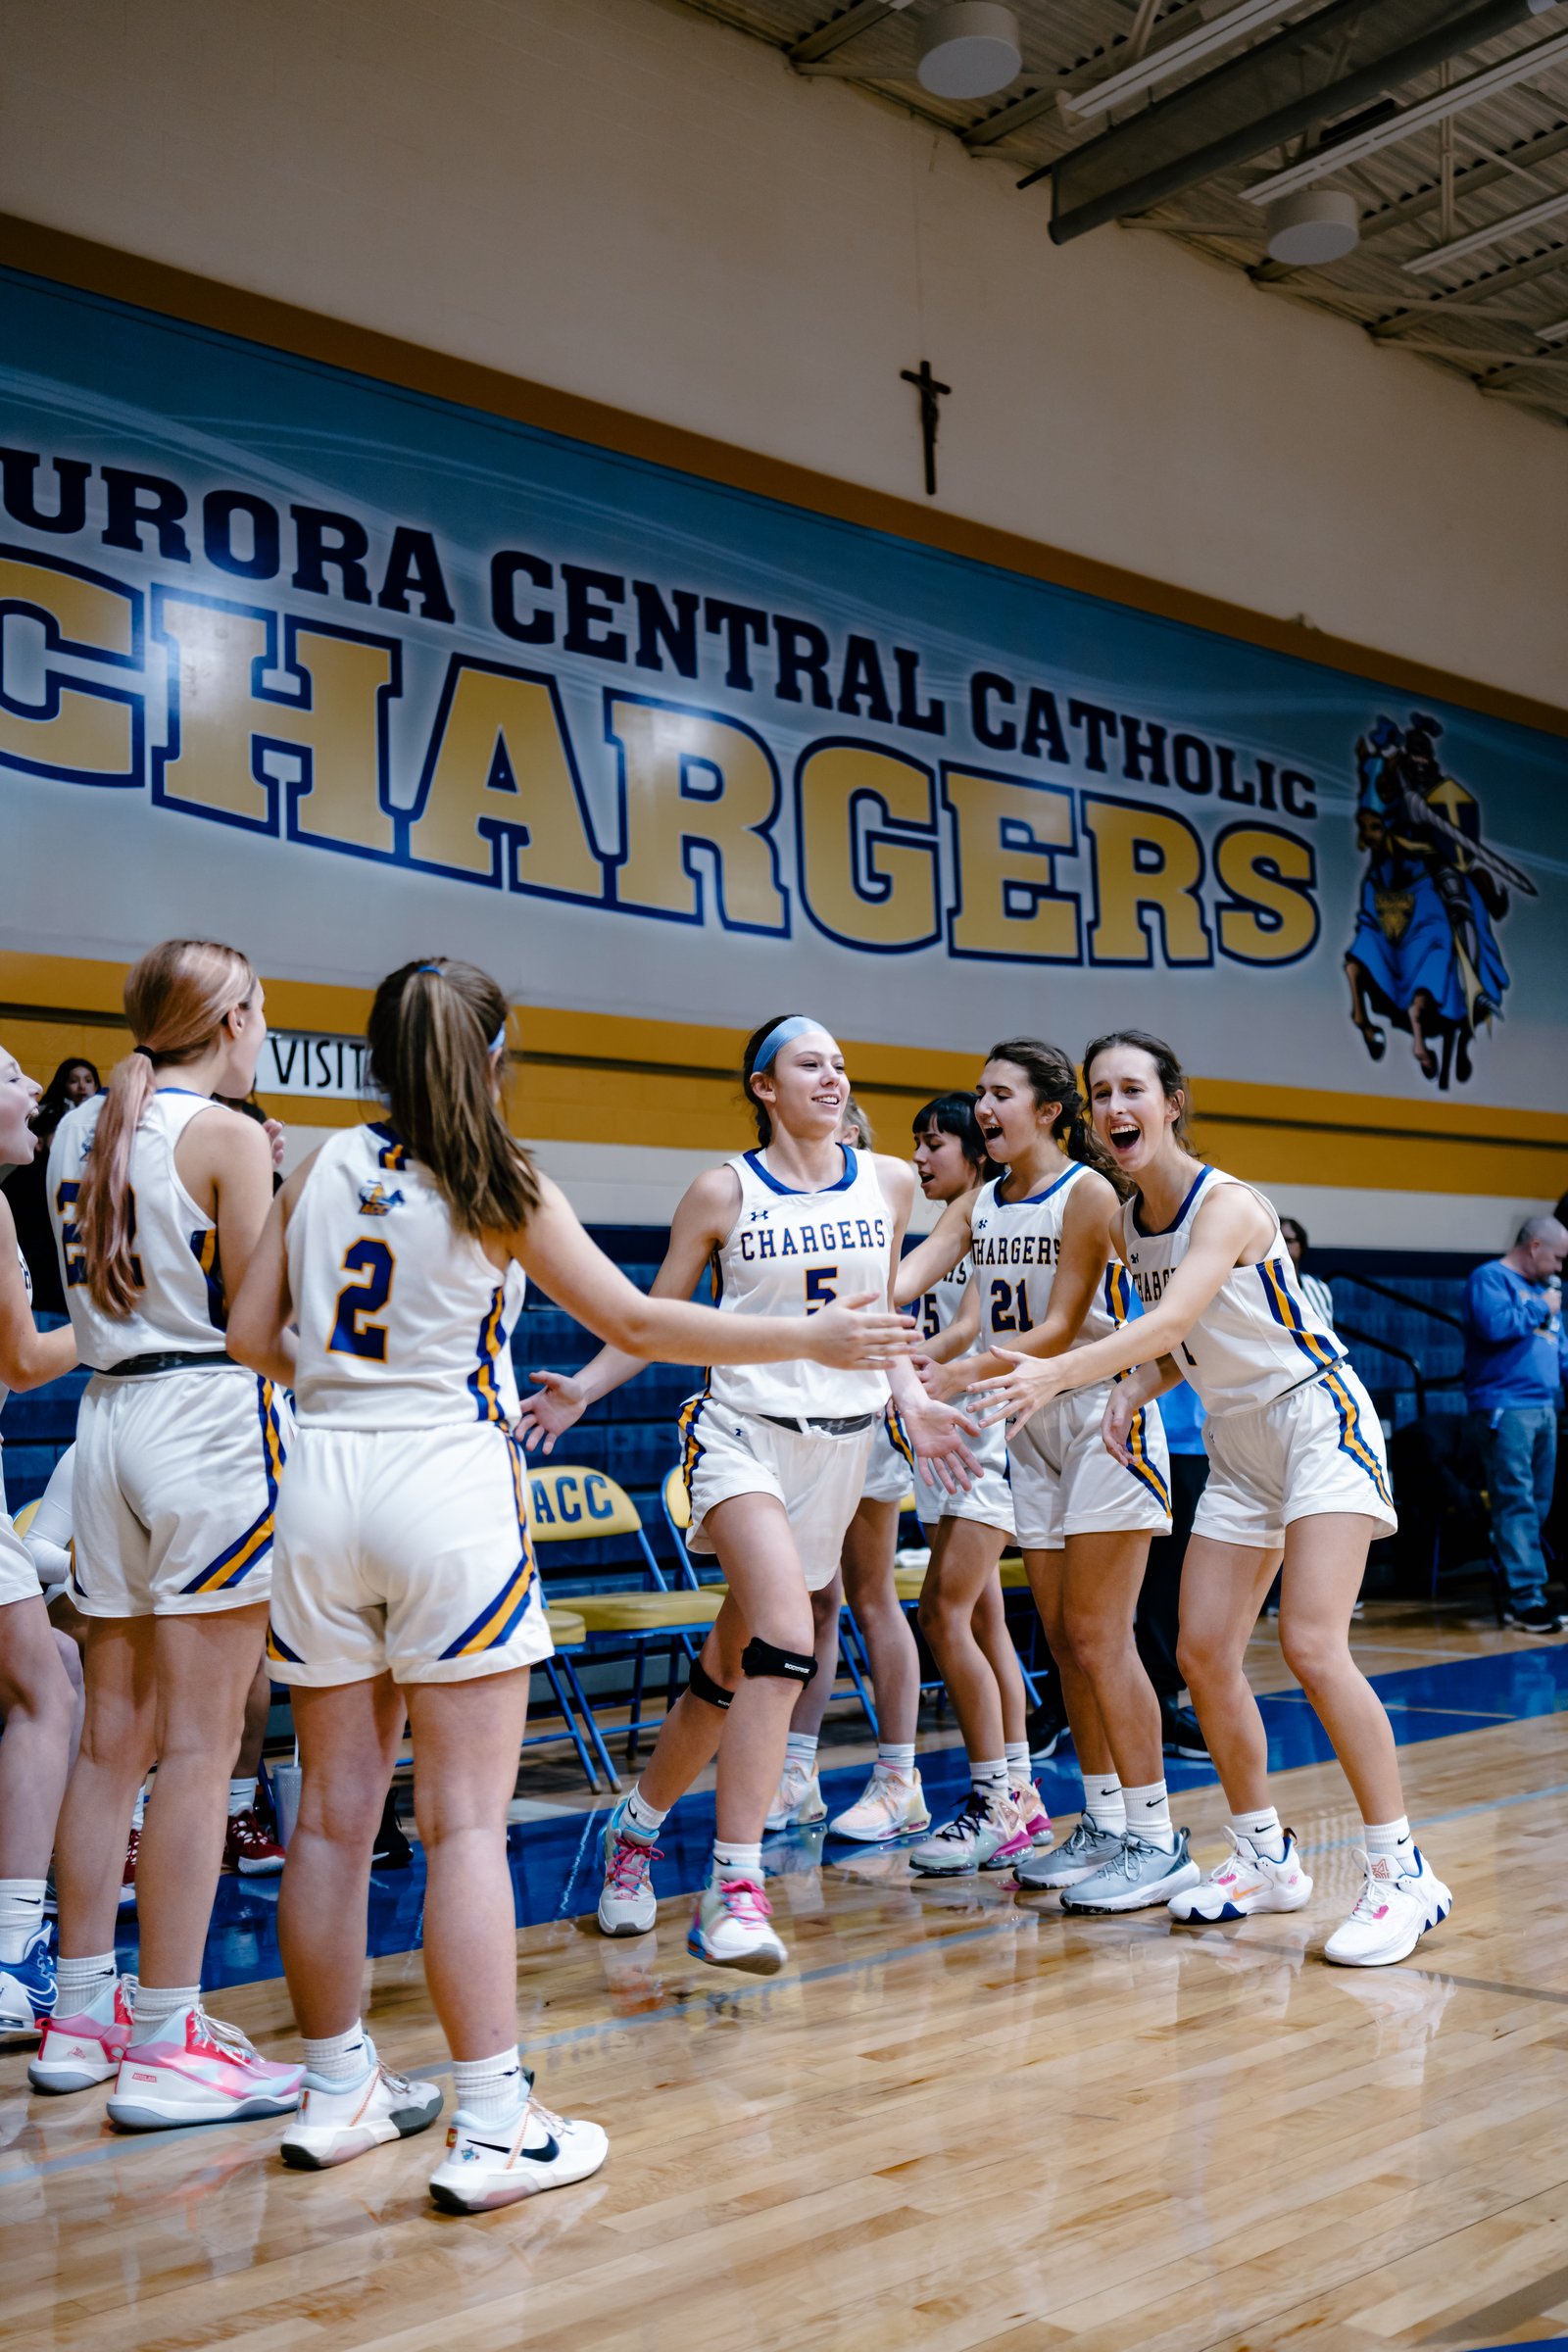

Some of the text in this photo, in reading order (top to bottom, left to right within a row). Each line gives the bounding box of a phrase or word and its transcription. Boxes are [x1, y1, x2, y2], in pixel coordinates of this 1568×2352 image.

[490, 550, 946, 736] CENTRAL
[969, 671, 1318, 818] CATHOLIC
[0, 542, 1321, 968] CHARGERS
[740, 1219, 885, 1261] CHARGERS
[325, 1236, 396, 1364] 2
[805, 1265, 840, 1317] 5
[990, 1277, 1035, 1334] 21
[530, 1474, 614, 1524] ACC
